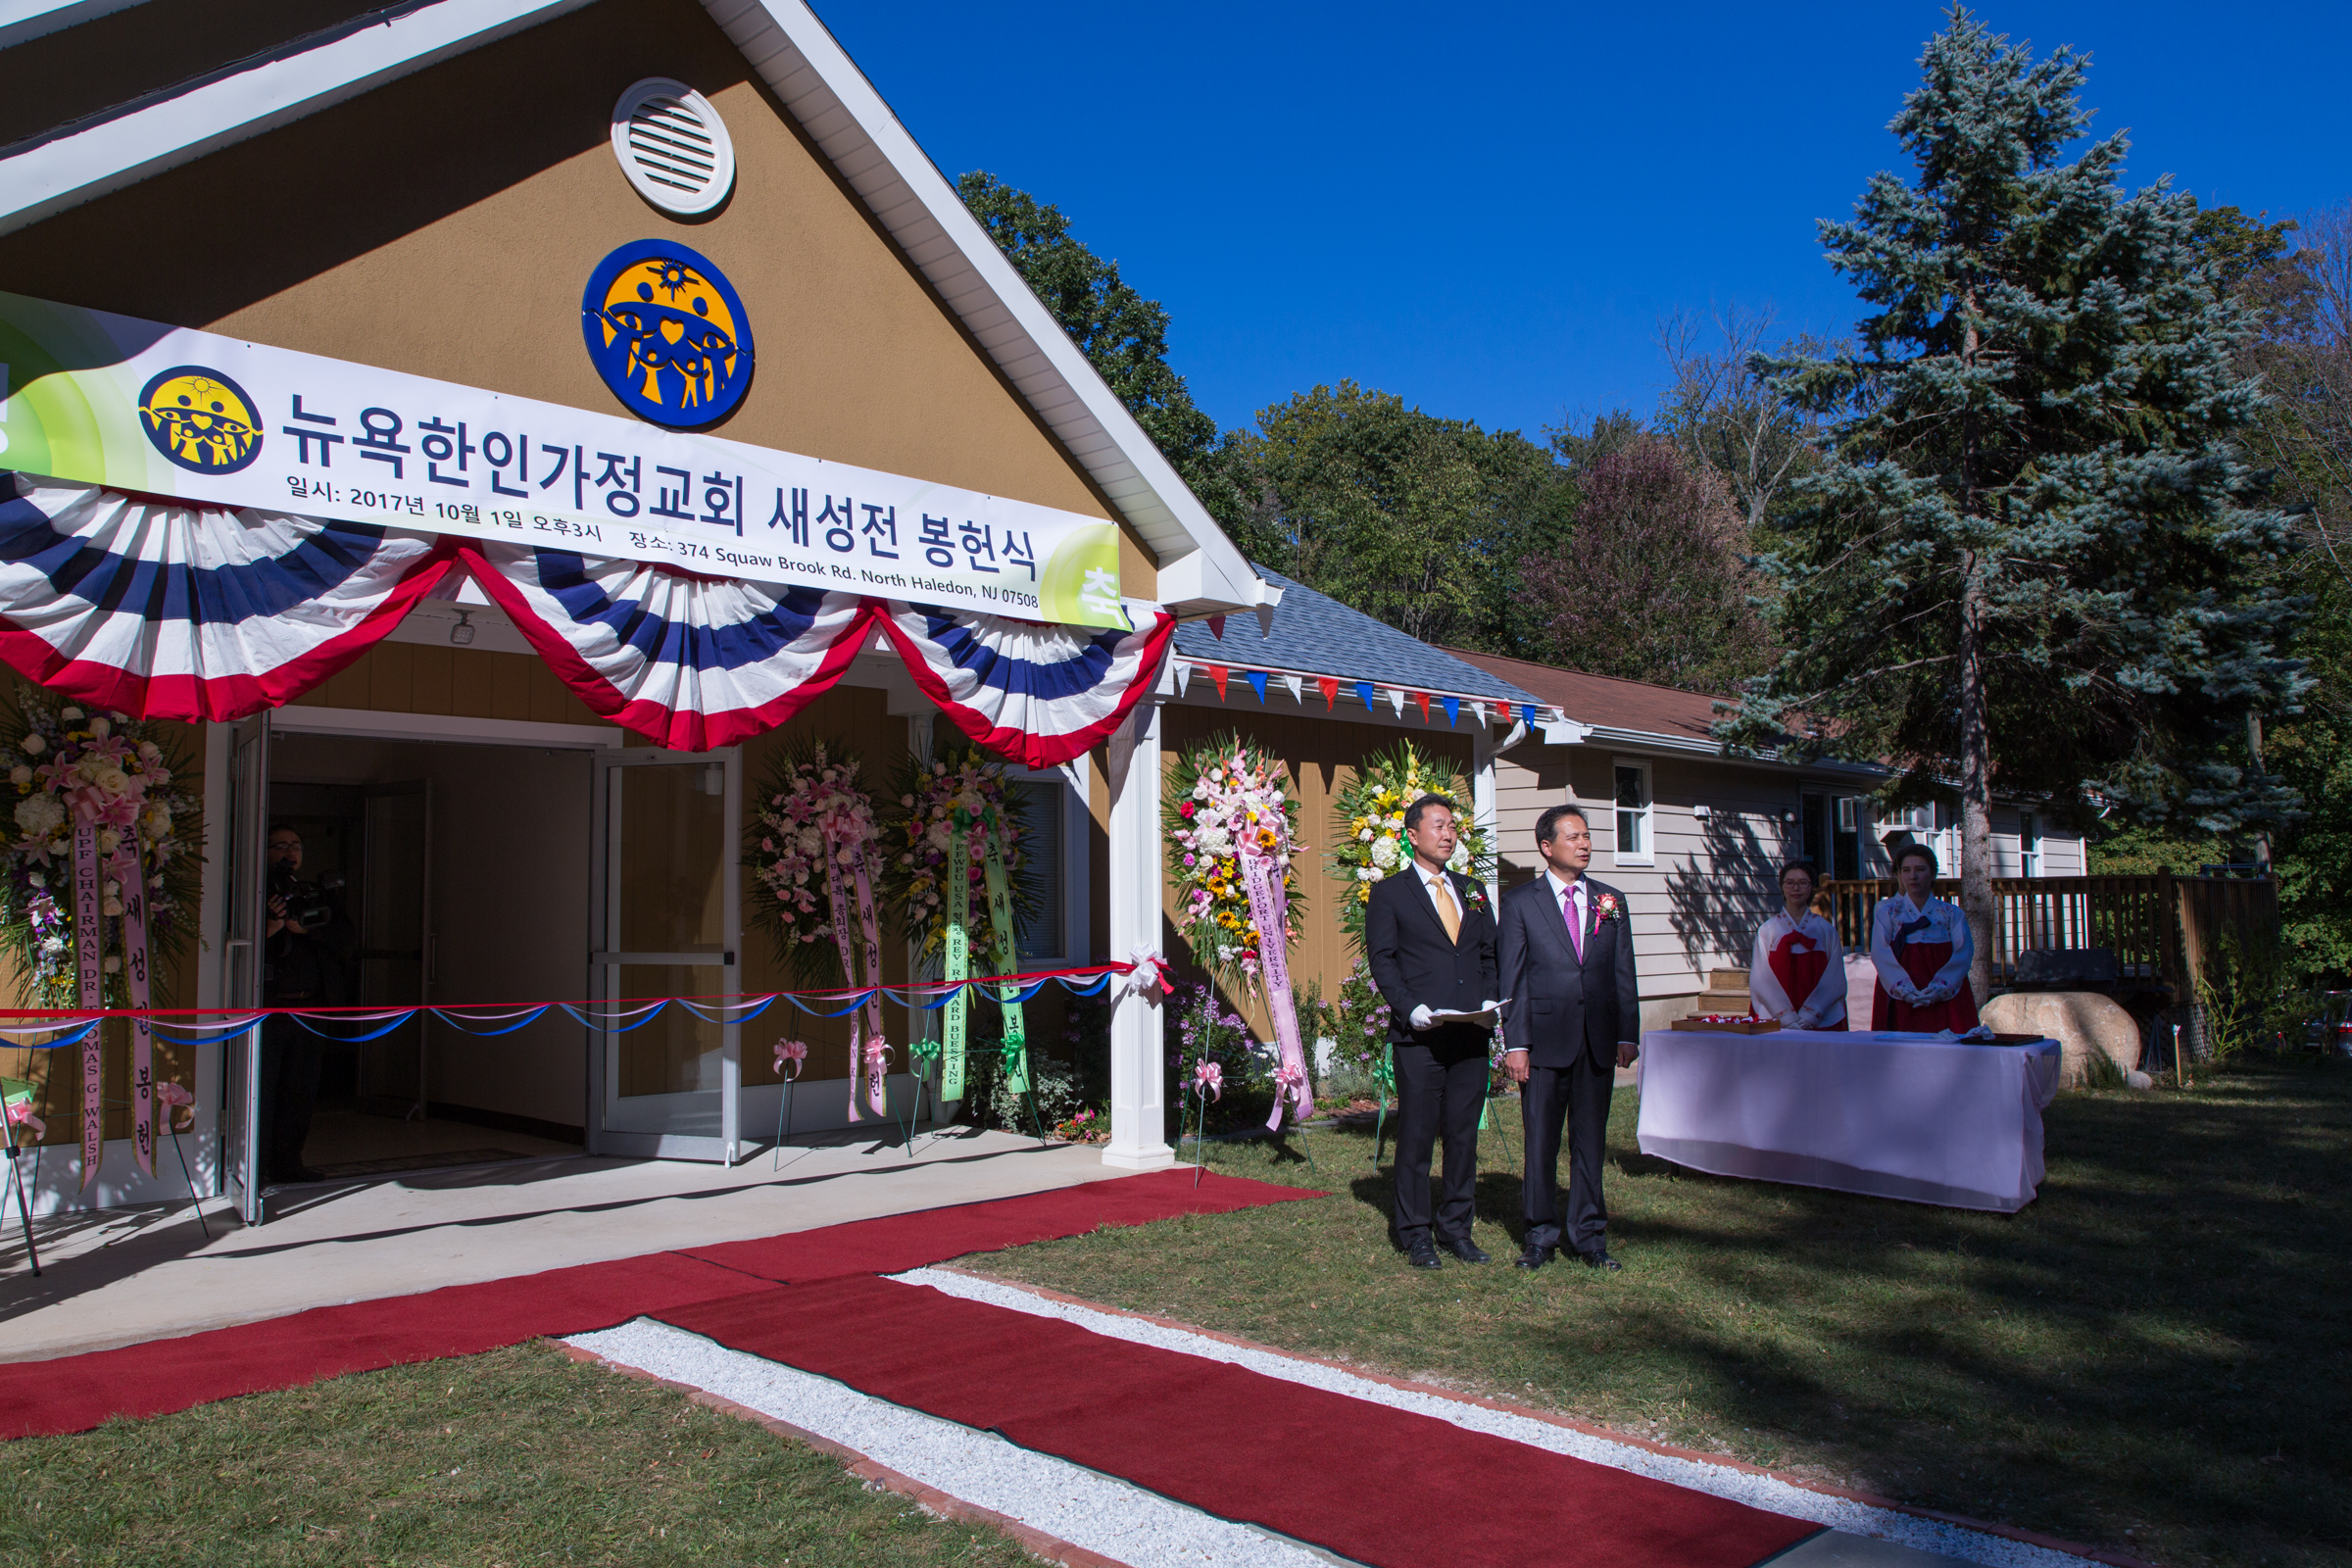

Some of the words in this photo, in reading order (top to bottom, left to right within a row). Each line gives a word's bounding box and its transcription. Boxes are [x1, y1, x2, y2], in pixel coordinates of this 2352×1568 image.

[283, 394, 744, 537] 뉴욕한인가정교회
[768, 487, 900, 560] 새성전
[918, 513, 1036, 582] 봉헌식
[286, 475, 341, 503] 일시:
[351, 488, 425, 516] 2017년
[436, 502, 481, 525] 10월
[491, 511, 524, 529] 1일
[534, 515, 602, 542] 오후3시
[629, 531, 673, 552] 장소:
[677, 542, 710, 560] 374
[715, 547, 772, 568] Squaw
[778, 556, 826, 576] Brook
[832, 564, 857, 582] Rd.
[861, 569, 906, 588] North
[911, 575, 977, 599] Haledon,
[982, 585, 998, 601] NJ
[1003, 589, 1039, 609] 07508
[1082, 566, 1126, 628] 축
[77, 827, 92, 859] UPF
[121, 825, 137, 858] 축
[953, 844, 966, 881] FFWPU
[79, 867, 98, 959] CHAIRMAN
[953, 885, 963, 907] USA
[1248, 858, 1270, 921] BRIDGEPORT
[1261, 924, 1283, 988] UNIVERSITY
[951, 969, 962, 1021] RIARD
[84, 1005, 100, 1076] OMAS
[948, 1025, 960, 1086] BUESSING
[84, 1106, 101, 1166] WALSH
